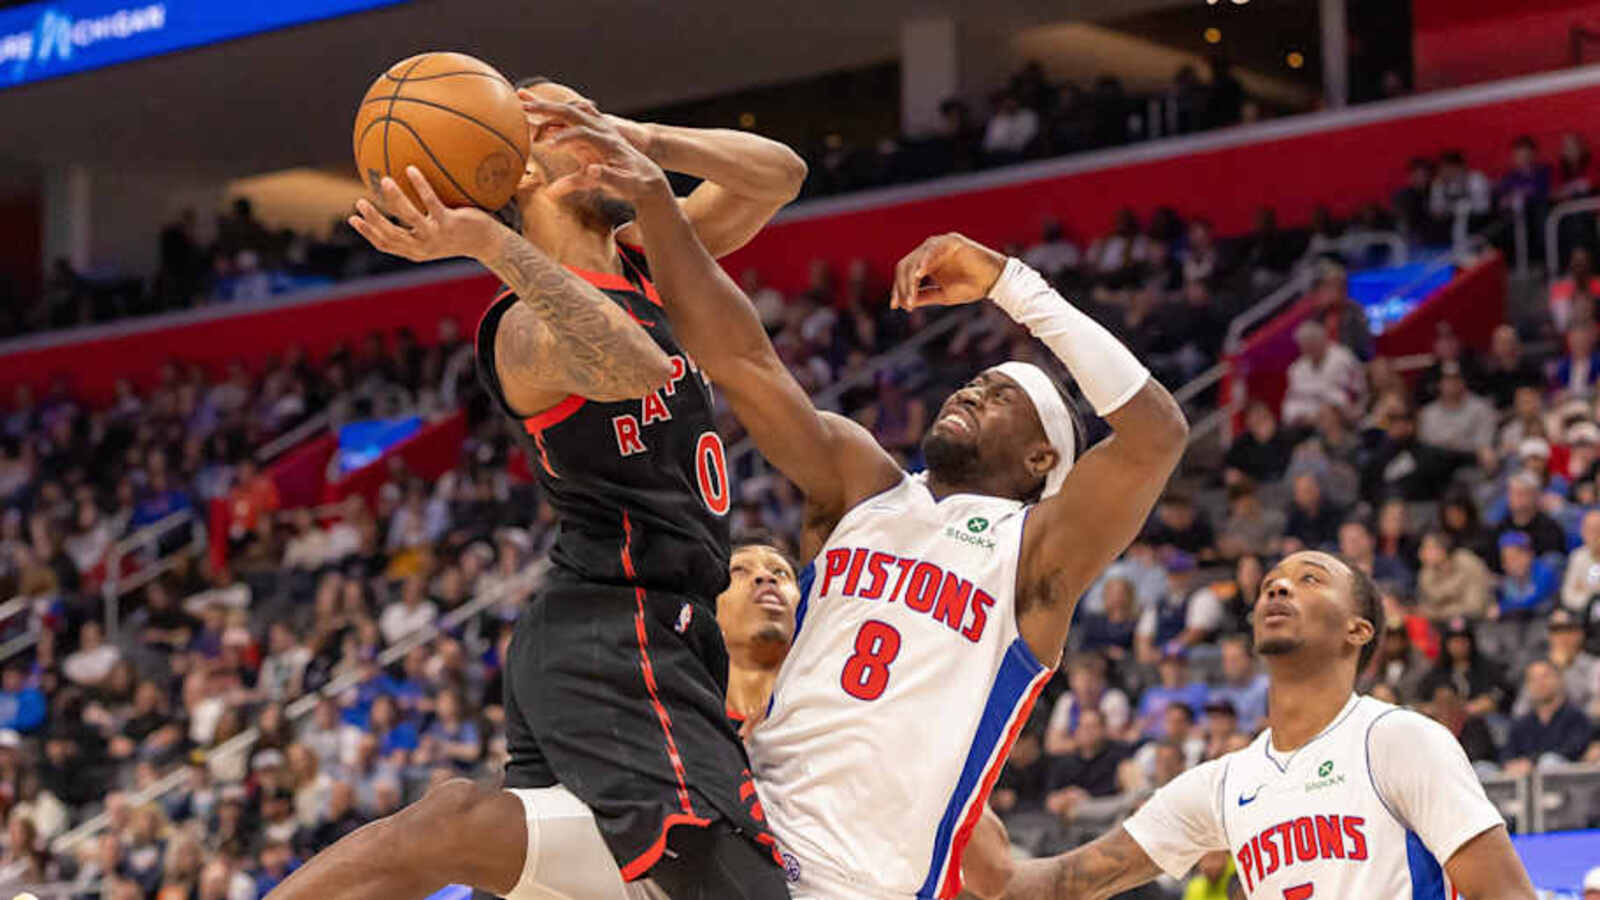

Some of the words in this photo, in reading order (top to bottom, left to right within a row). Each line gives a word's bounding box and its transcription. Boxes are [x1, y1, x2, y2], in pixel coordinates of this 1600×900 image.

[696, 431, 730, 516] 0
[819, 547, 996, 643] PISTONS
[840, 619, 901, 701] 8
[1236, 814, 1369, 894] PISTONS
